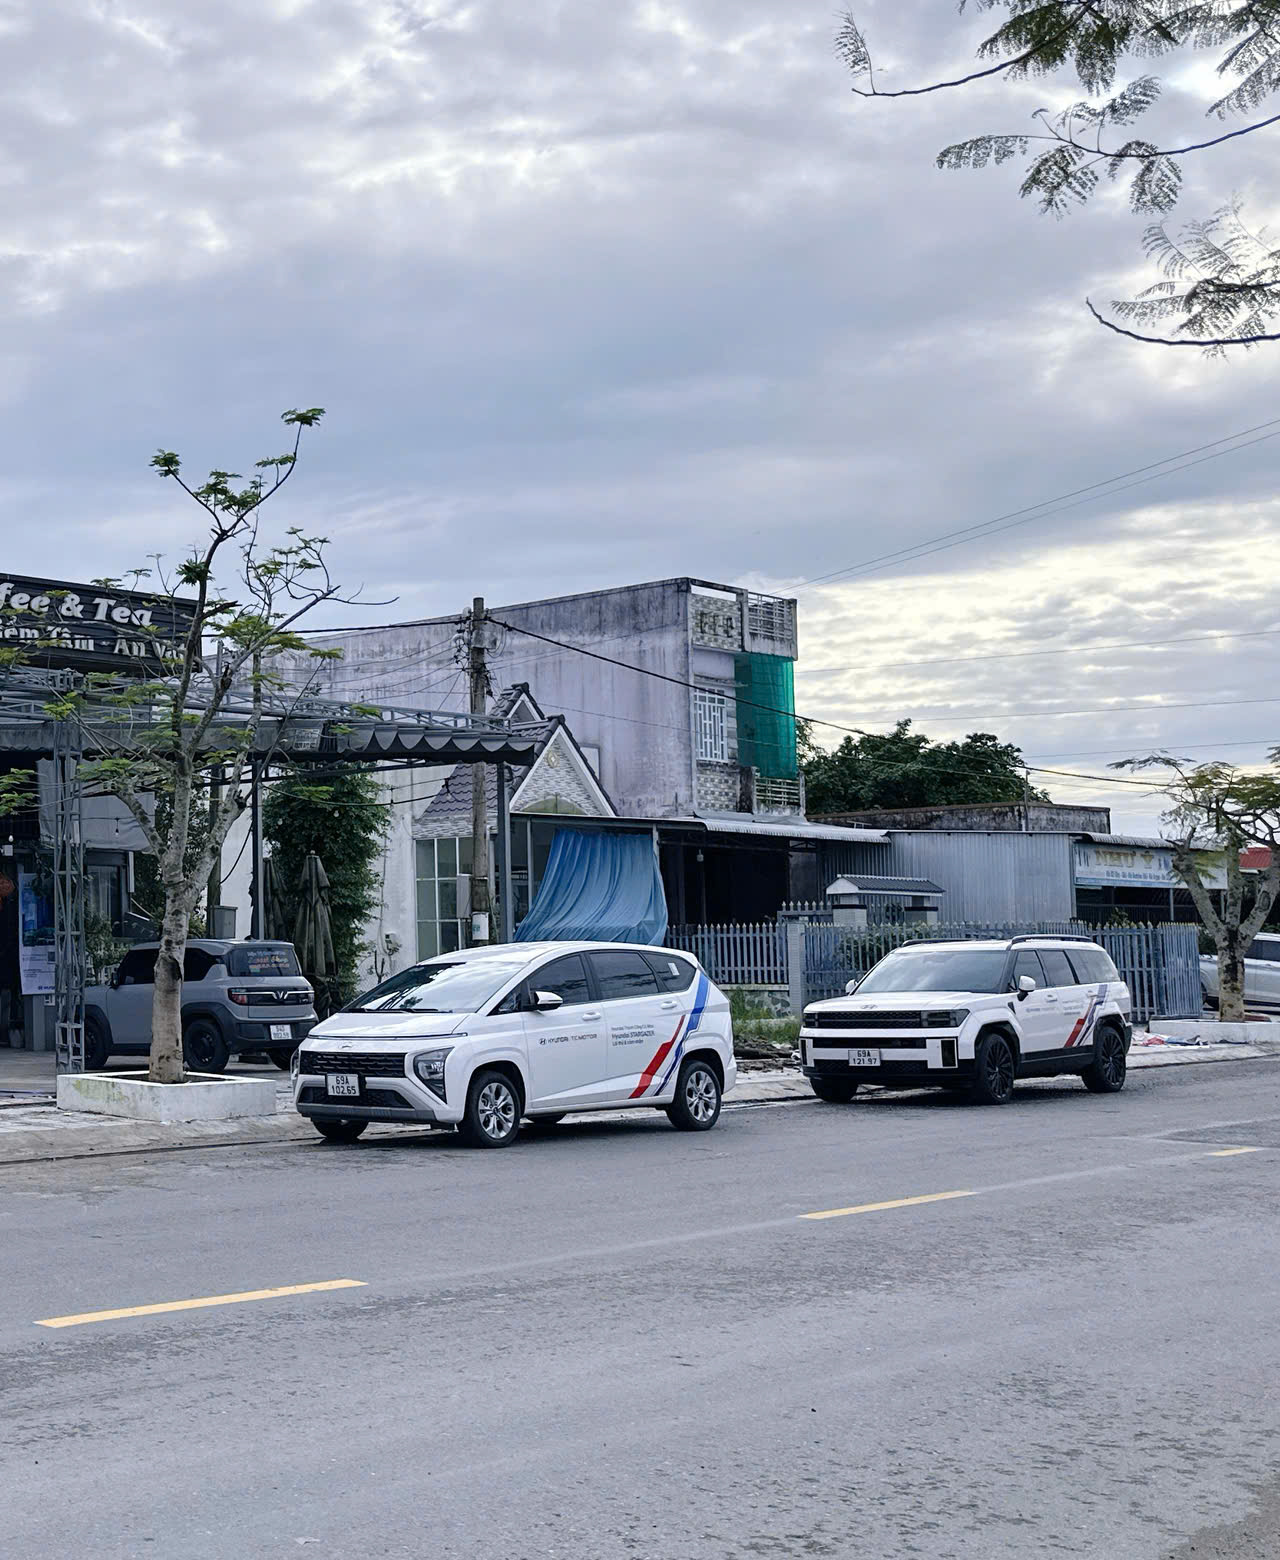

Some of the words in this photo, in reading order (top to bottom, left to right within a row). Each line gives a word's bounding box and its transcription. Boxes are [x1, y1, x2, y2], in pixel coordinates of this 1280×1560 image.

[60, 593, 85, 618] &
[92, 597, 153, 627] Tea
[857, 1050, 871, 1058] 69A
[335, 1075, 350, 1085] 69A
[331, 1085, 357, 1095] 102.65
